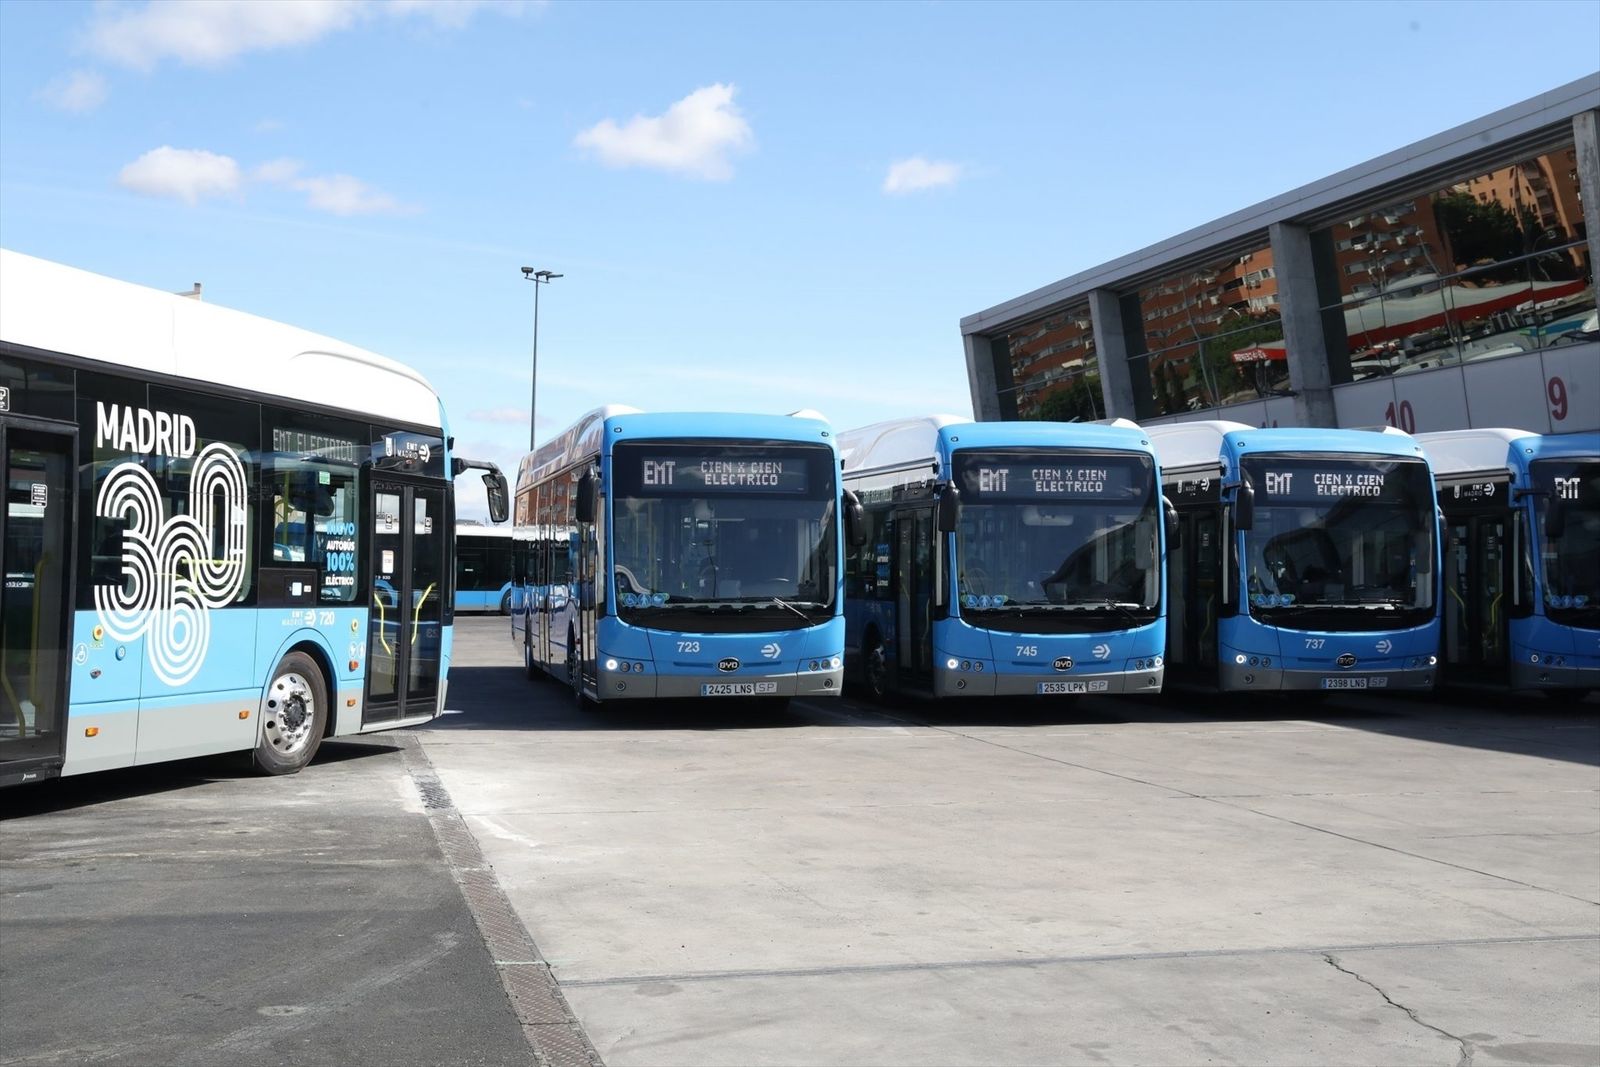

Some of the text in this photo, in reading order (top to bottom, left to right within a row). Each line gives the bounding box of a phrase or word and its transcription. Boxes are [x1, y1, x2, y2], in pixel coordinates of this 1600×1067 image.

[1548, 376, 1568, 421] 9
[1385, 400, 1415, 435] 10
[96, 401, 196, 459] MADRID
[273, 428, 353, 462] EMT ELECTRICO
[406, 442, 418, 451] EMT
[397, 450, 418, 460] MADRID
[644, 461, 675, 485] EMT
[701, 461, 782, 474] CIEN X CIEN
[705, 474, 778, 486] ELECTRICO
[980, 469, 1009, 492] EMT
[1032, 469, 1107, 481] CIEN X CIEN
[1314, 473, 1384, 486] CIEN X CIEN
[1035, 481, 1103, 492] ELECTRICO
[1265, 472, 1293, 495] EMT
[1317, 485, 1380, 496] ELECTRICO
[326, 521, 355, 536] NUEVO
[326, 538, 355, 551] AUTOBÚS
[326, 552, 355, 571] 100%
[325, 574, 354, 586] ELÉCTRICO
[319, 611, 335, 625] 720
[677, 641, 700, 653] 723
[1305, 639, 1326, 649] 737
[1016, 646, 1038, 657] 745
[758, 683, 775, 692] SP
[1091, 681, 1106, 690] SP
[1328, 679, 1366, 688] 2398 LNS
[1371, 677, 1386, 686] SP
[708, 684, 752, 695] 2425 LNS
[1044, 683, 1085, 693] 2535 LPK
